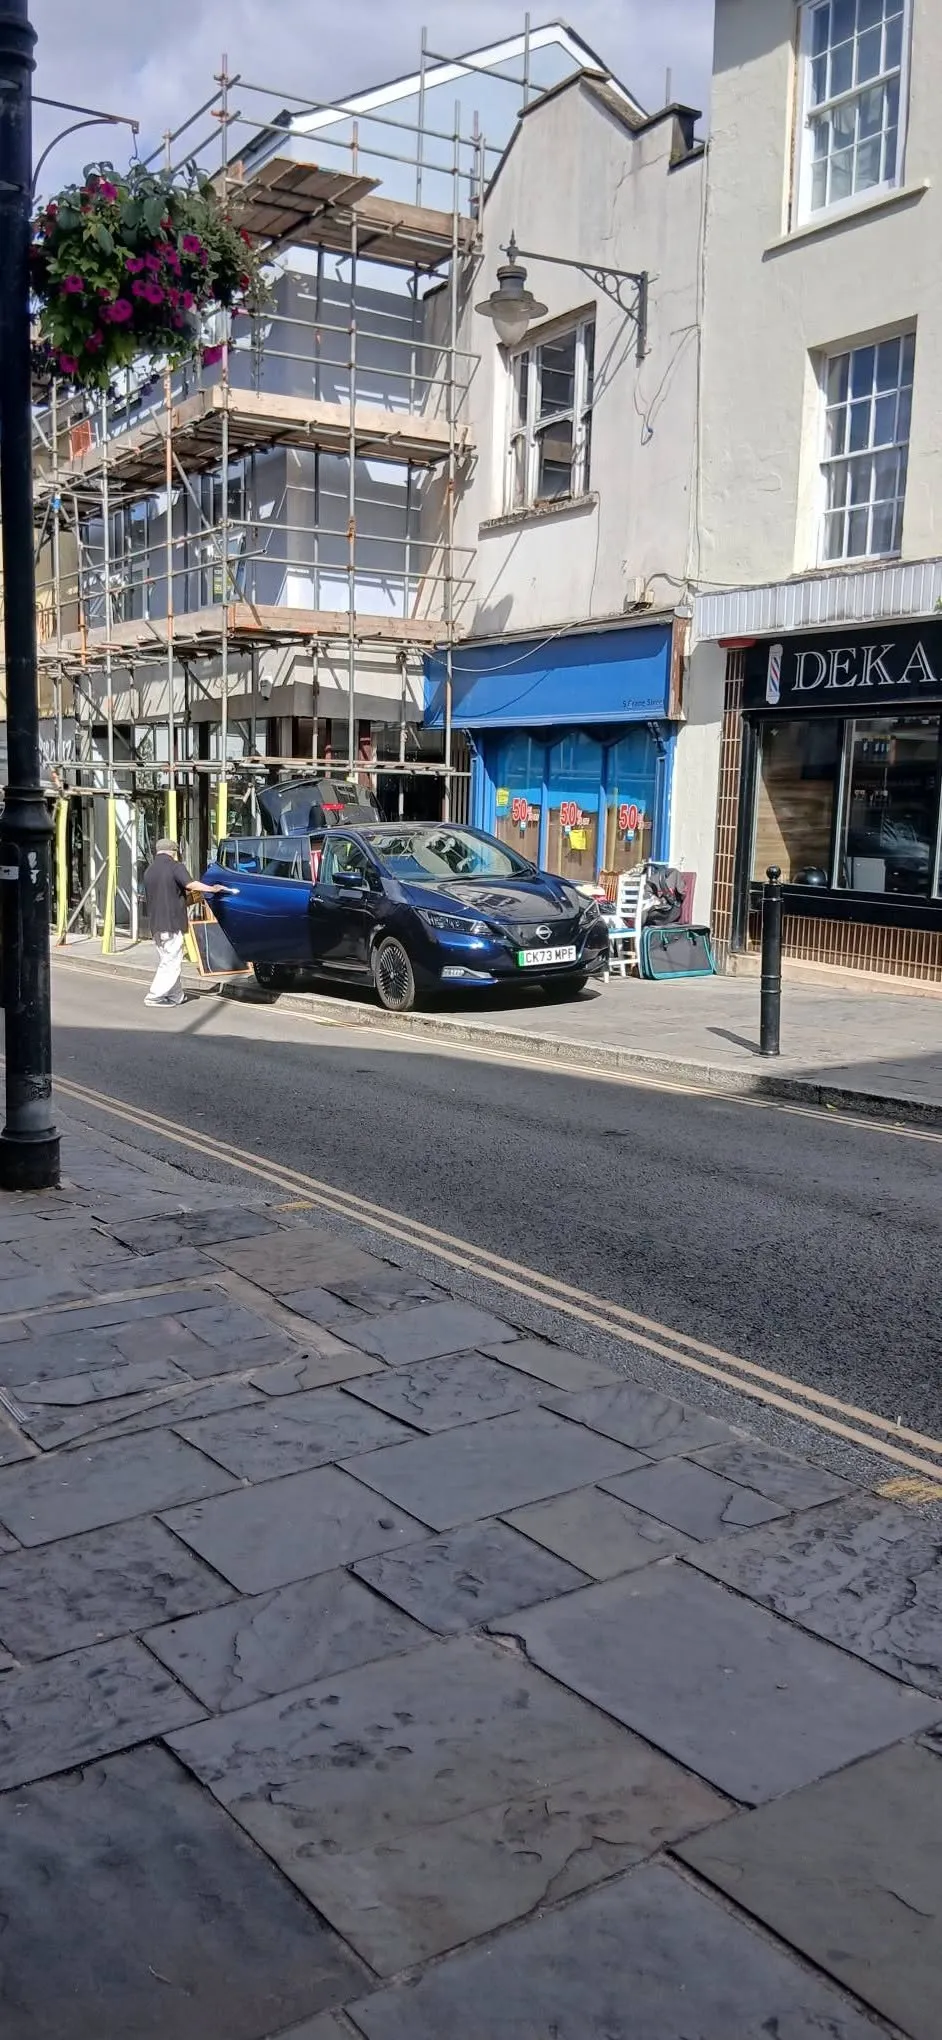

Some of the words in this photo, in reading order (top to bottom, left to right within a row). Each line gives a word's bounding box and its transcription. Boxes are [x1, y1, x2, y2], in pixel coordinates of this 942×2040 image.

[791, 640, 942, 691] DEKA
[526, 950, 553, 963] CK73
[554, 948, 574, 960] MPF
